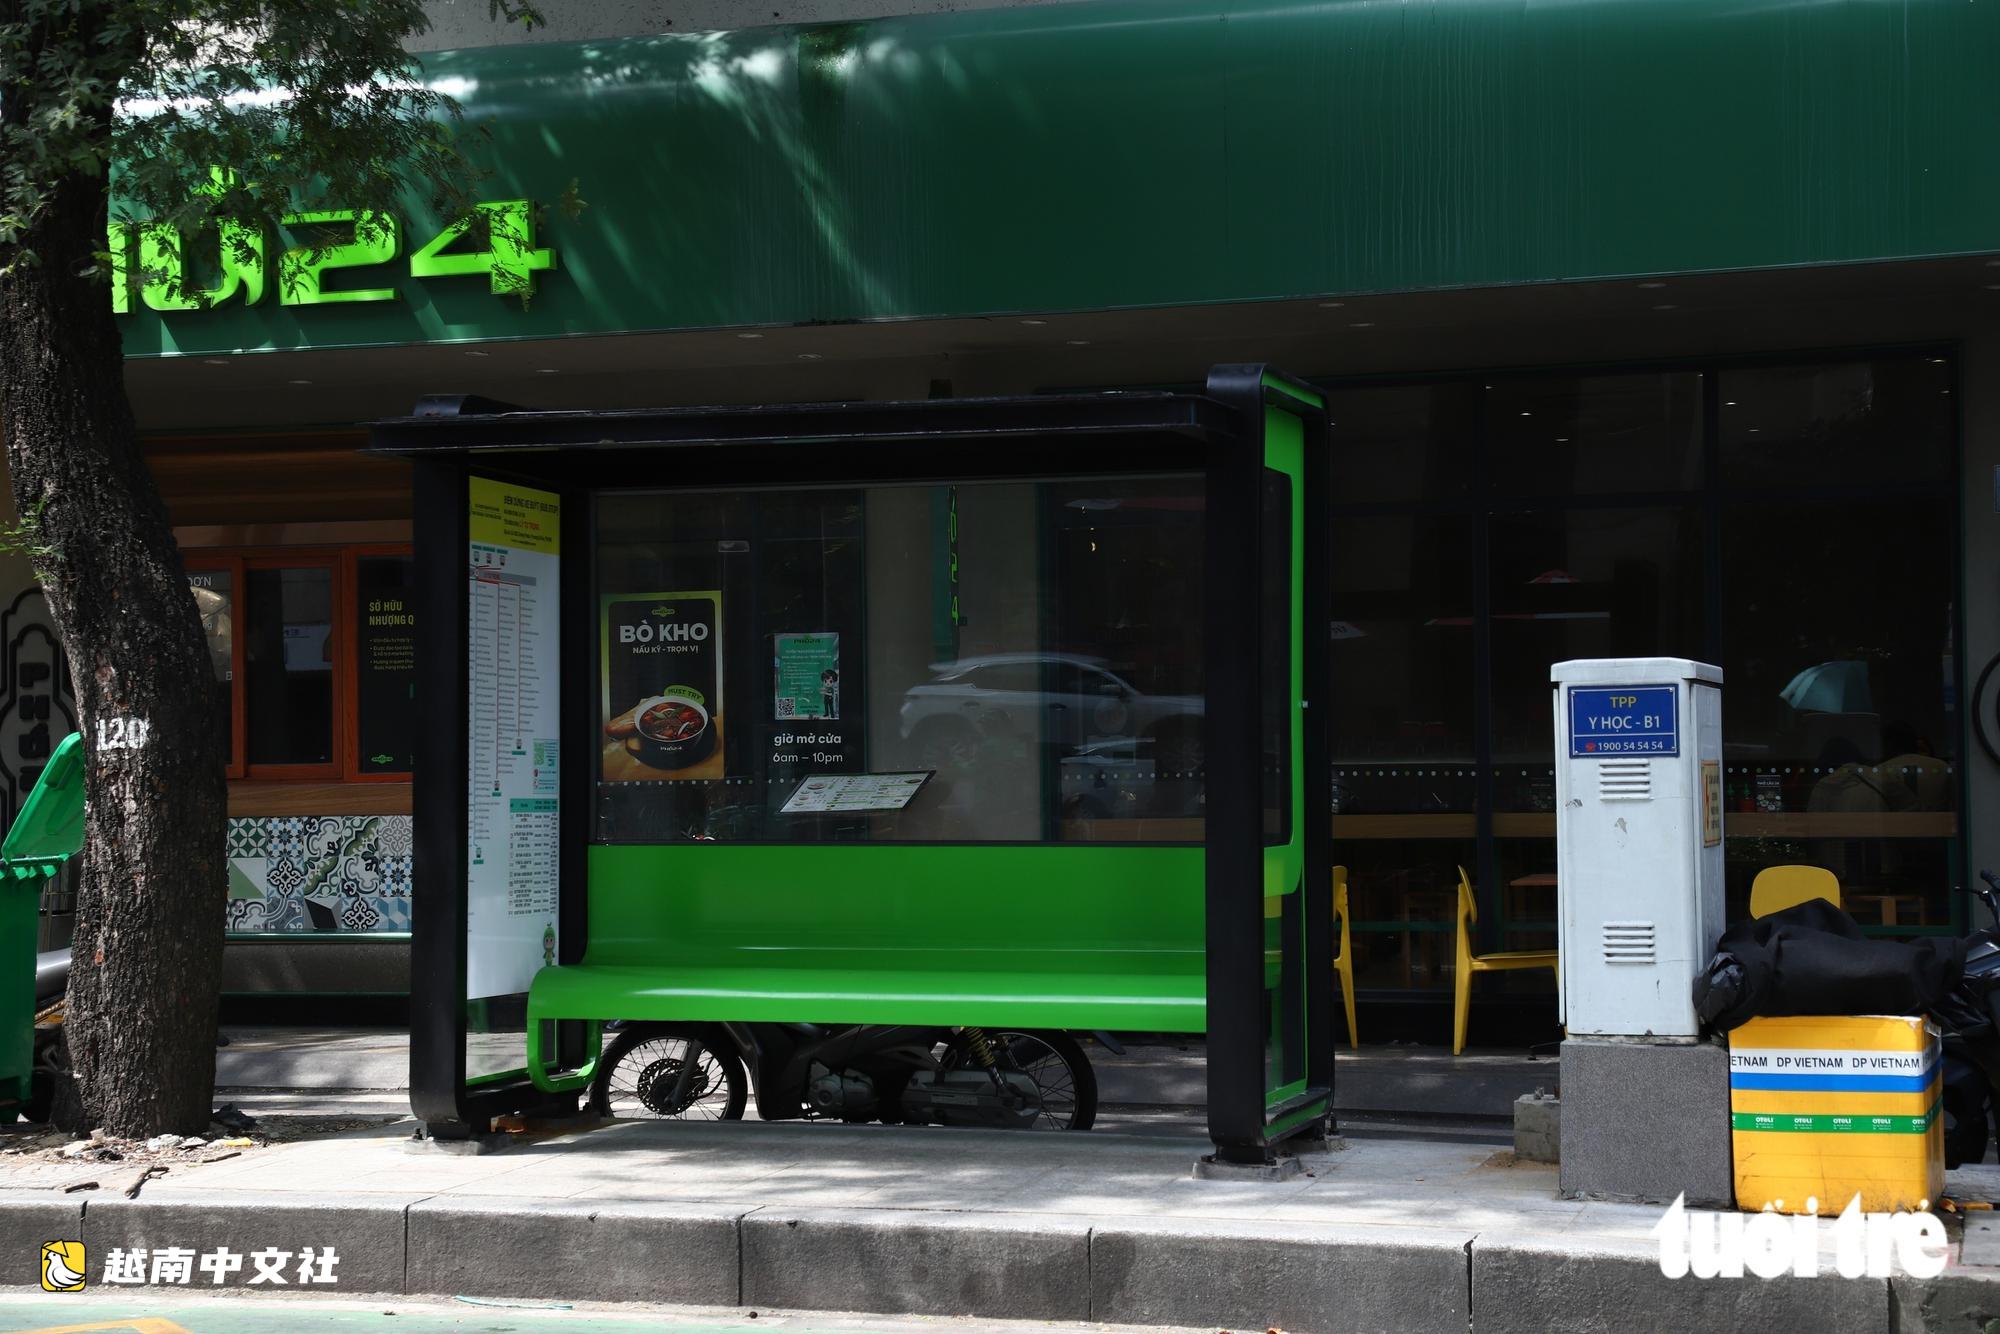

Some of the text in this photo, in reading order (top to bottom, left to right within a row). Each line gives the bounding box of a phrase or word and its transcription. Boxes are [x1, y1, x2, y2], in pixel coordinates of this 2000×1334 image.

[620, 619, 709, 643] BÒ KHO
[1609, 696, 1637, 708] TPP
[1588, 716, 1598, 730] Y
[1601, 715, 1632, 732] HỌC
[1644, 715, 1660, 729] B1
[774, 731, 842, 746] giờ mở cửa
[1598, 741, 1663, 751] 1900 54 54 54
[773, 752, 799, 763] 6am
[813, 751, 843, 764] 10pm
[1776, 1057, 1791, 1068] DP
[1794, 1057, 1843, 1068] VIETNAM
[1852, 1058, 1867, 1068] DP
[1869, 1058, 1920, 1069] VIETNAM
